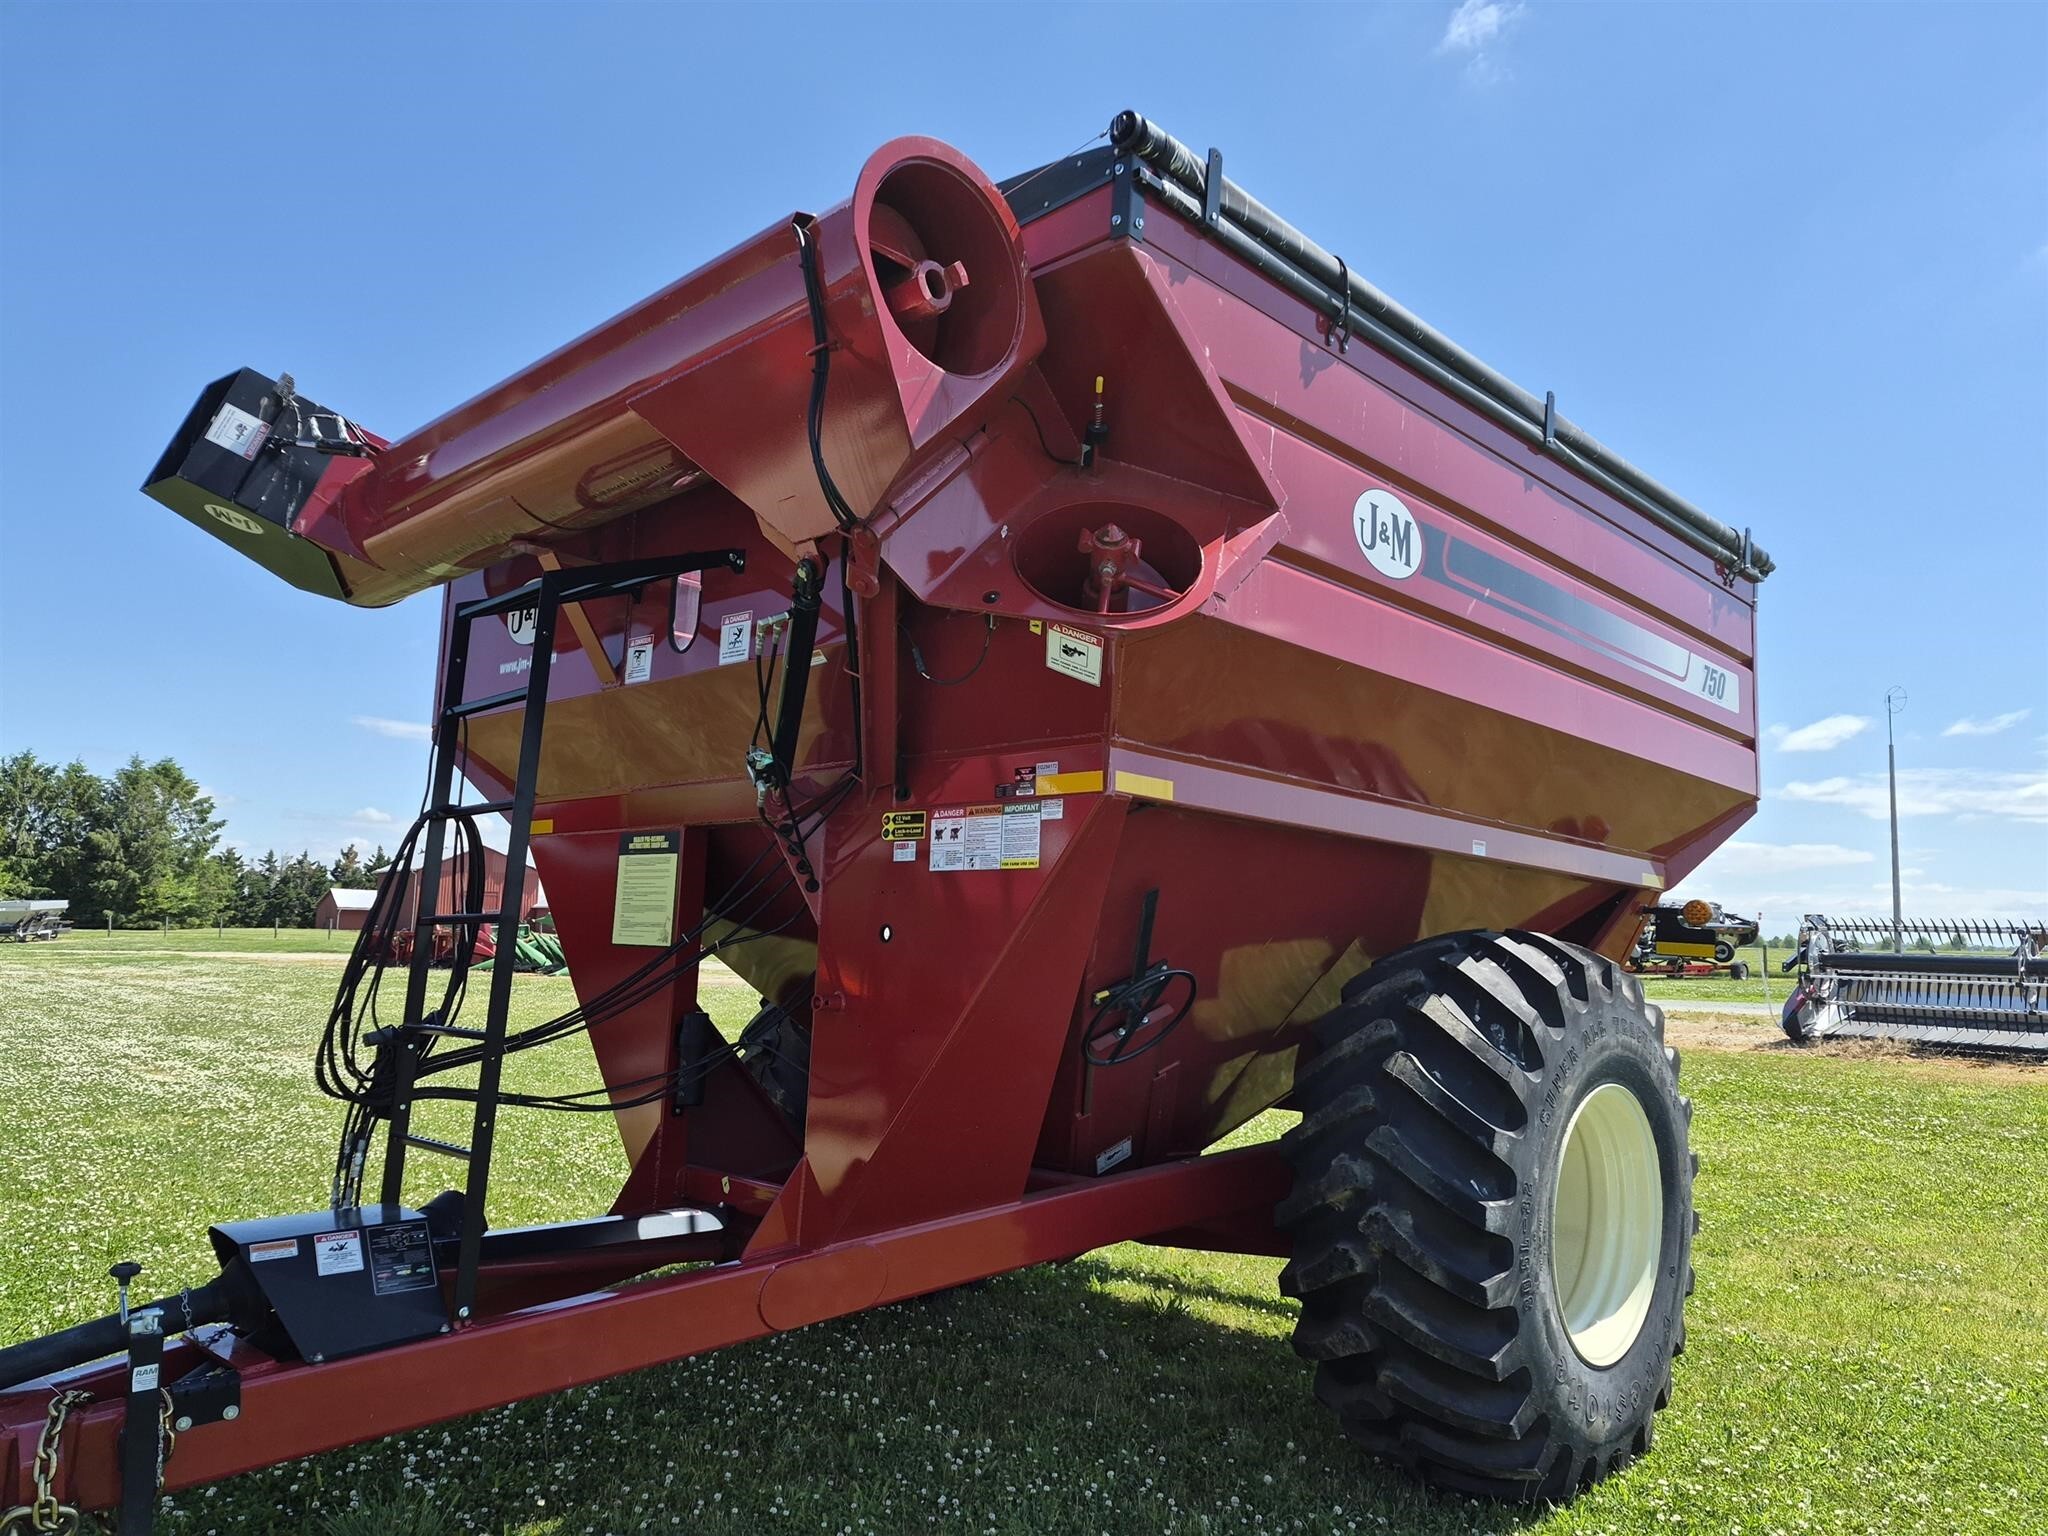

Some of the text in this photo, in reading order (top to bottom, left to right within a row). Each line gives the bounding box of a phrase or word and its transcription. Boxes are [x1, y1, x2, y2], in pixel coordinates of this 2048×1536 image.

[1360, 501, 1412, 569] J&M
[730, 614, 750, 624] DANGER
[1062, 627, 1098, 645] DANGER
[1702, 663, 1727, 701] 750
[940, 809, 964, 817] DANGER
[974, 806, 1001, 815] WARNING
[1004, 803, 1039, 814] IMPORTANT
[327, 1233, 354, 1241] DANGER
[135, 1367, 158, 1377] RAM
